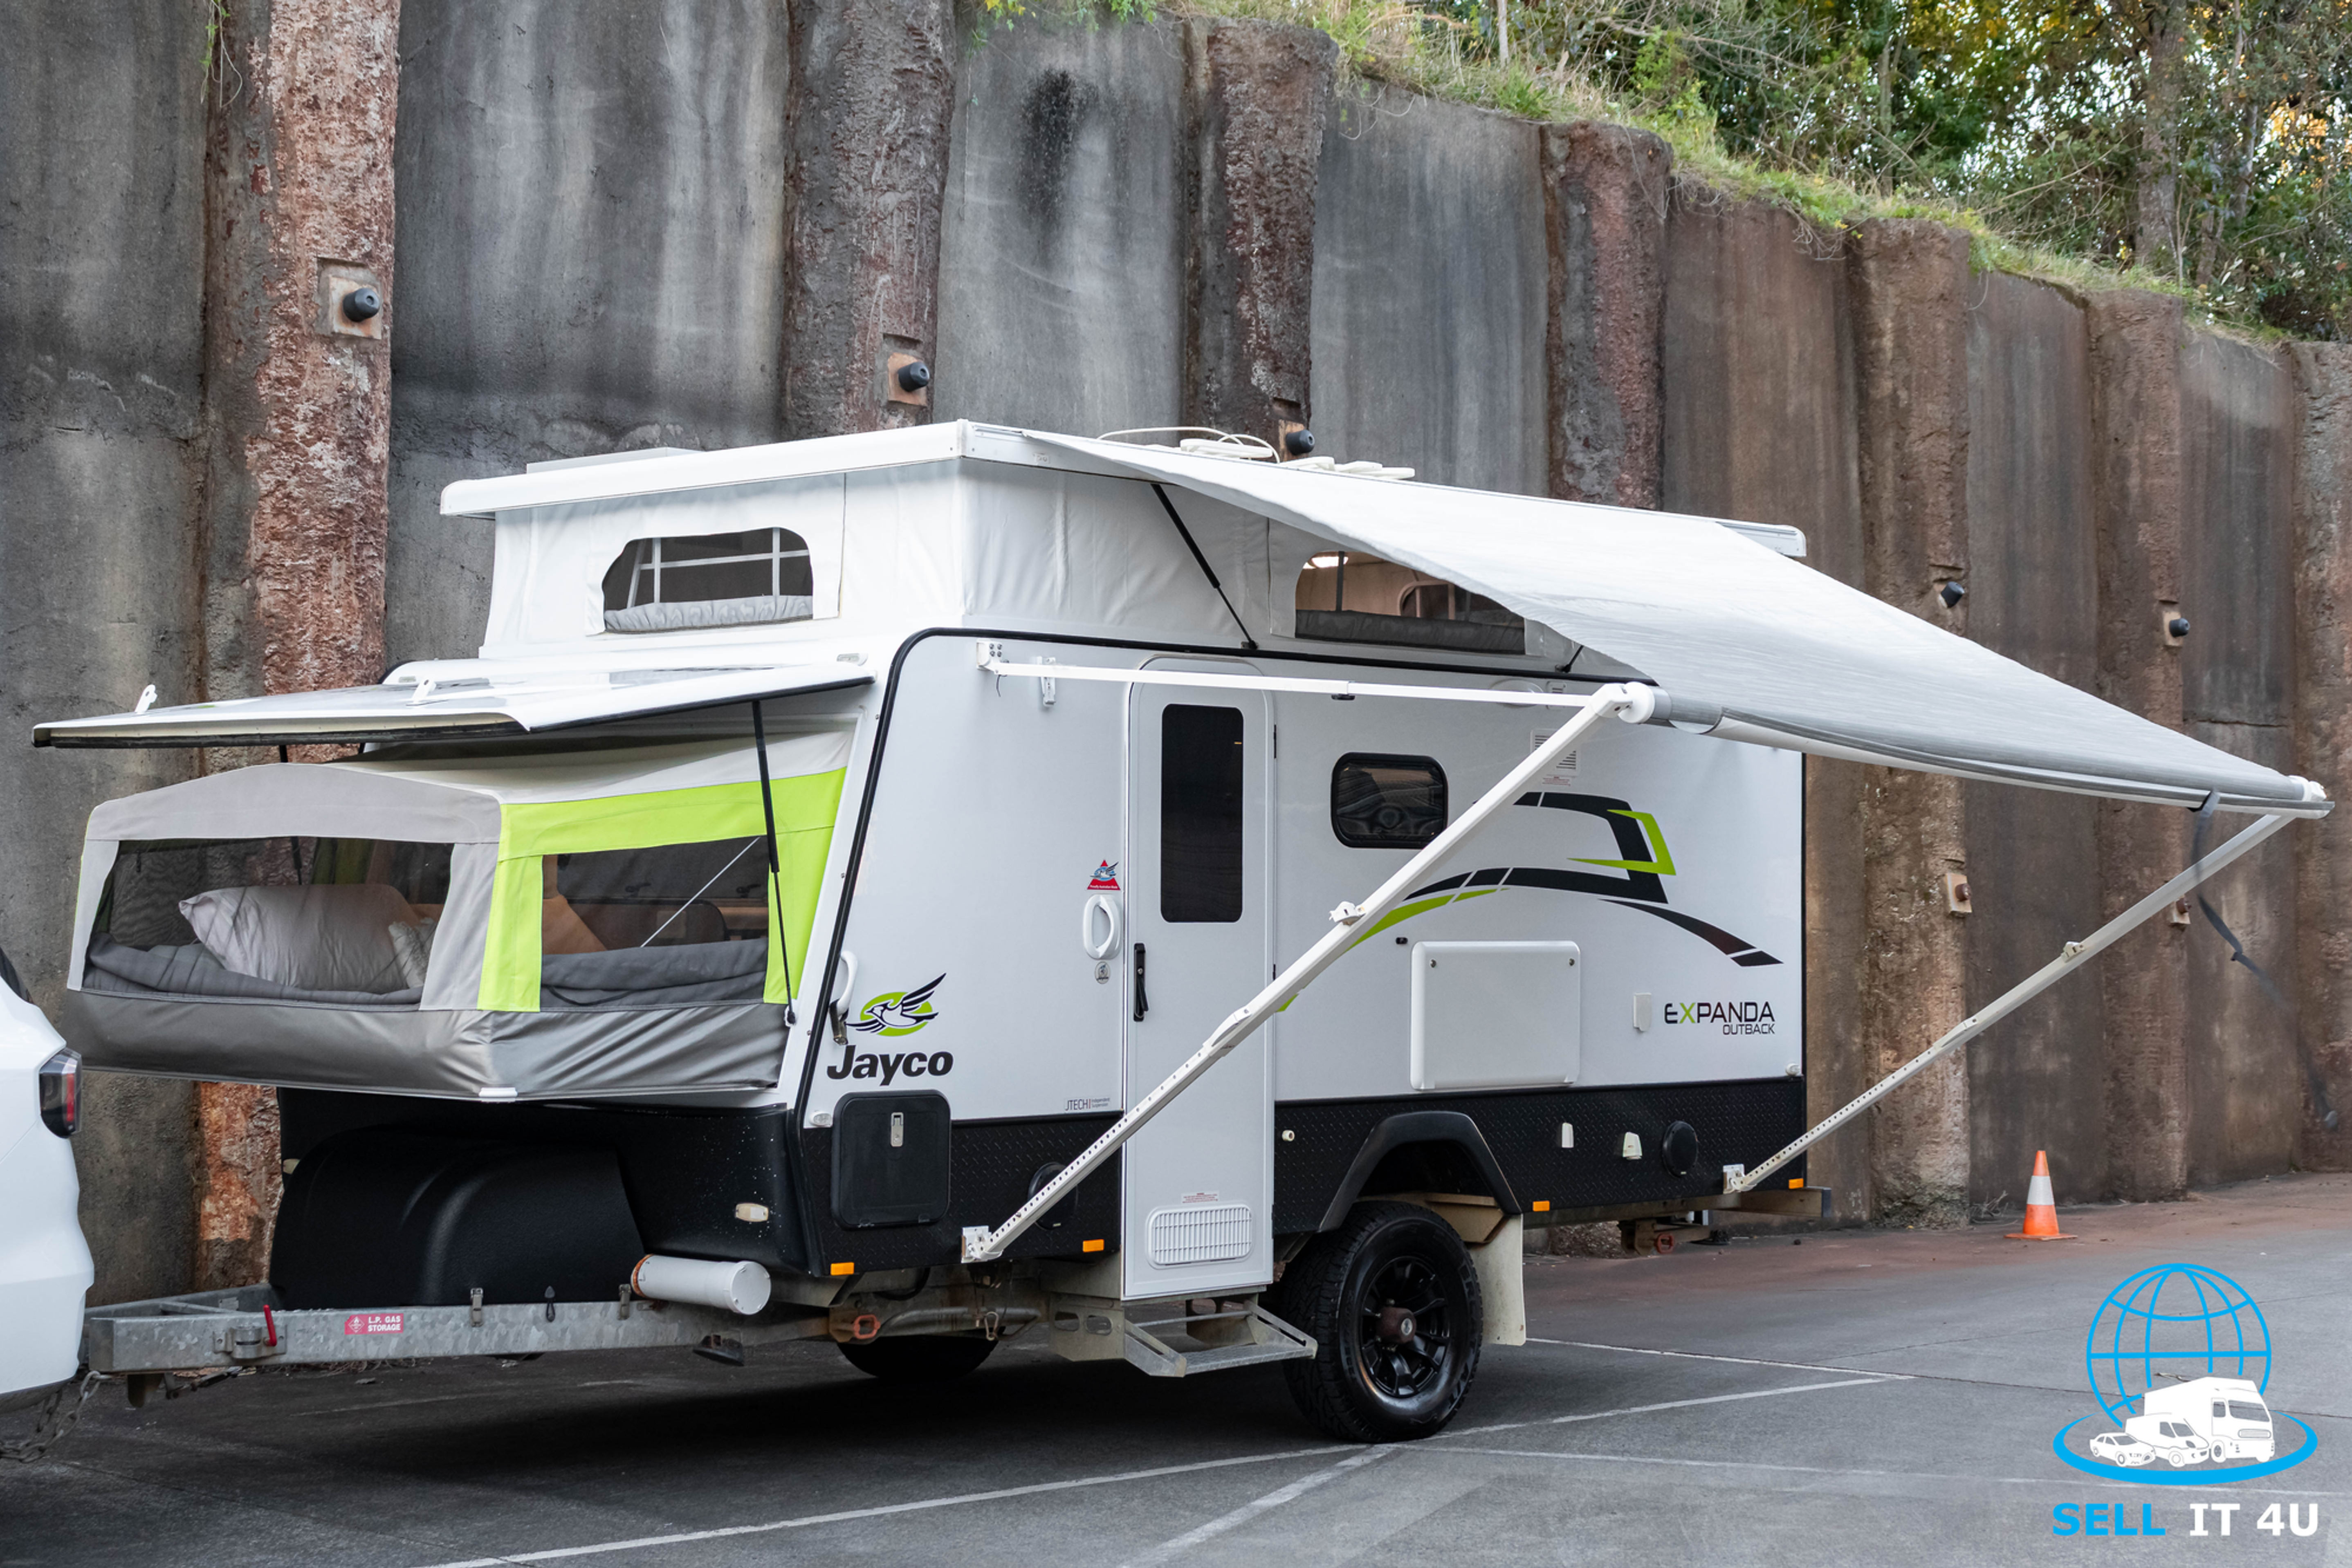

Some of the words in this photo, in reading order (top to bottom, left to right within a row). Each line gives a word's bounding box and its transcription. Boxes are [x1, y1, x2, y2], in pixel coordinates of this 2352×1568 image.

[1664, 1001, 1775, 1025] EXPANDA
[1723, 1023, 1775, 1035] OUTBACK
[827, 1045, 953, 1086] Jayco
[368, 1323, 401, 1332] STORAGE
